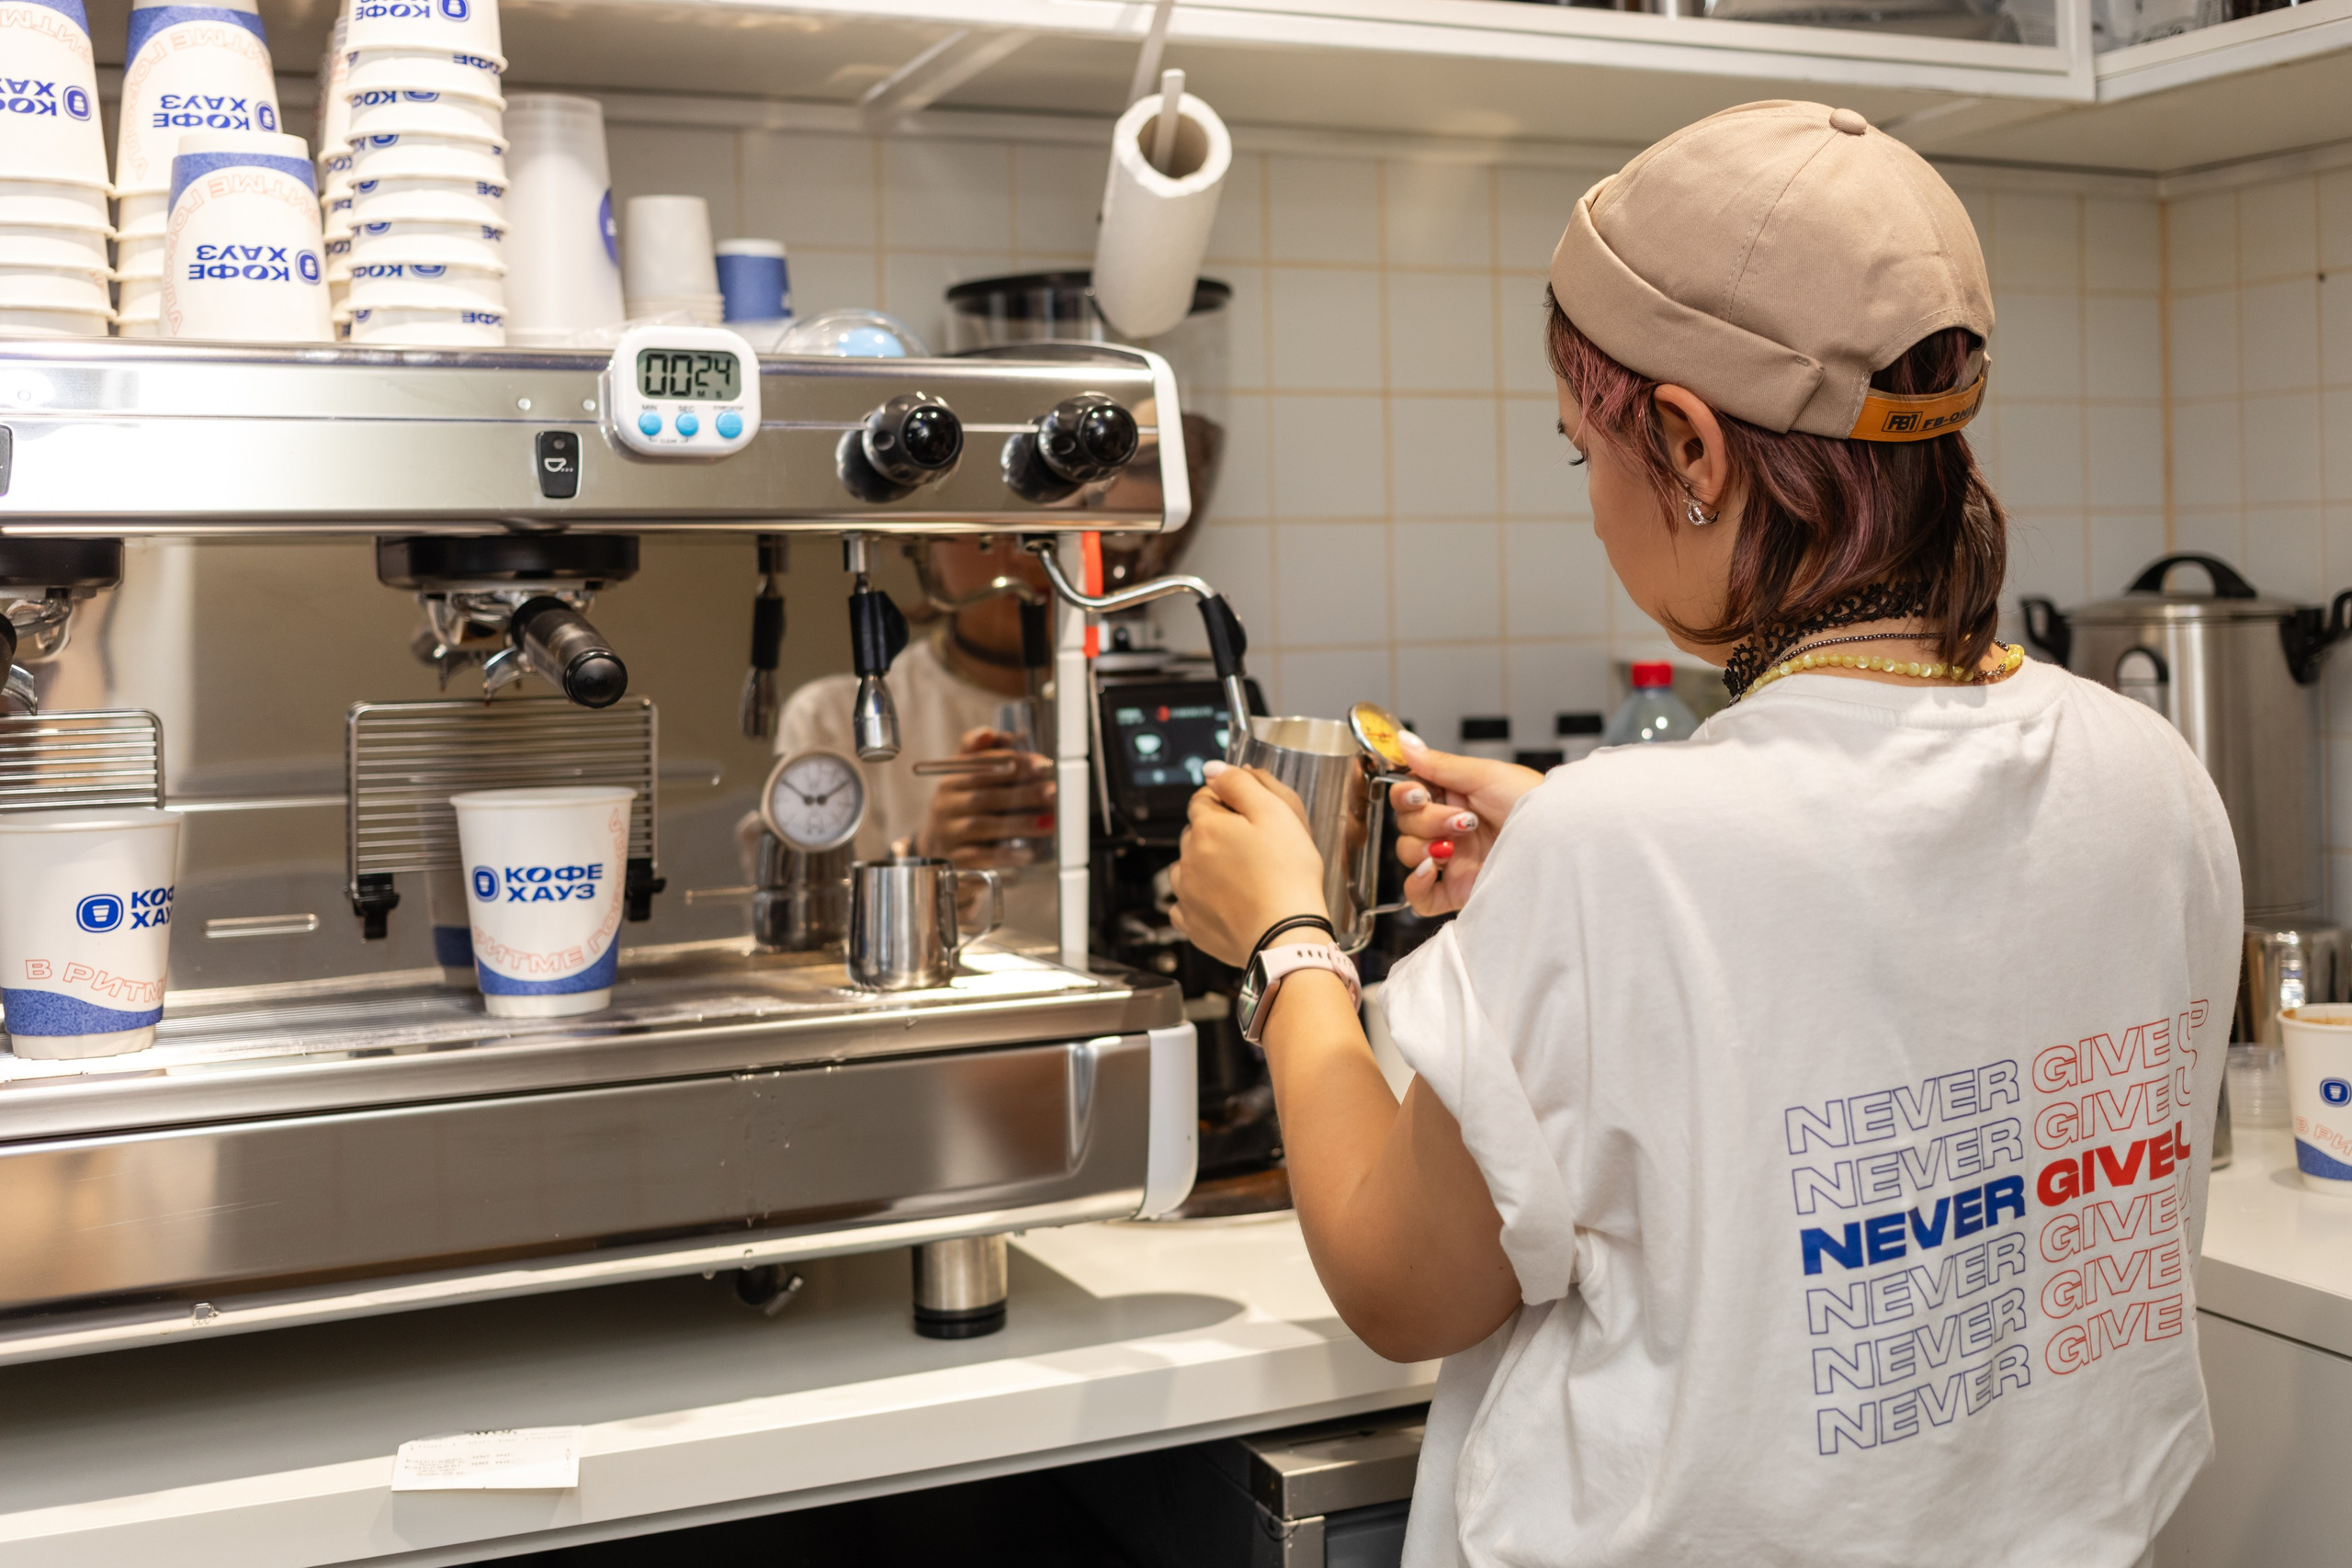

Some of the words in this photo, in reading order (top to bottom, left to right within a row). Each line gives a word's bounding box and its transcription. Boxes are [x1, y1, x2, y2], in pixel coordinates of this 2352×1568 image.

[355, 4, 431, 21] КОФЕ
[160, 94, 248, 113] ХАУЗ
[153, 112, 250, 130] КОФЕ
[197, 243, 288, 263] ХАУЗ
[188, 263, 290, 282] КОФЕ
[505, 863, 603, 884] КОФЕ
[506, 884, 596, 903] ХАУЗ
[25, 959, 52, 980] В
[63, 962, 167, 1003] РИТМ
[1785, 1059, 2020, 1155] NEVER
[2032, 1018, 2170, 1093] GIVE
[1792, 1117, 2023, 1215] NEVER
[2034, 1074, 2170, 1150] GIVE
[1800, 1175, 2026, 1275] NEVER
[2037, 1129, 2175, 1207] GIVE
[1806, 1232, 2026, 1335] NEVER
[2040, 1183, 2178, 1263] GIVE
[1813, 1288, 2027, 1394] NEVER
[2041, 1238, 2182, 1319] GIVE
[1817, 1344, 2030, 1455] NEVER
[2045, 1293, 2183, 1375] GIVE
